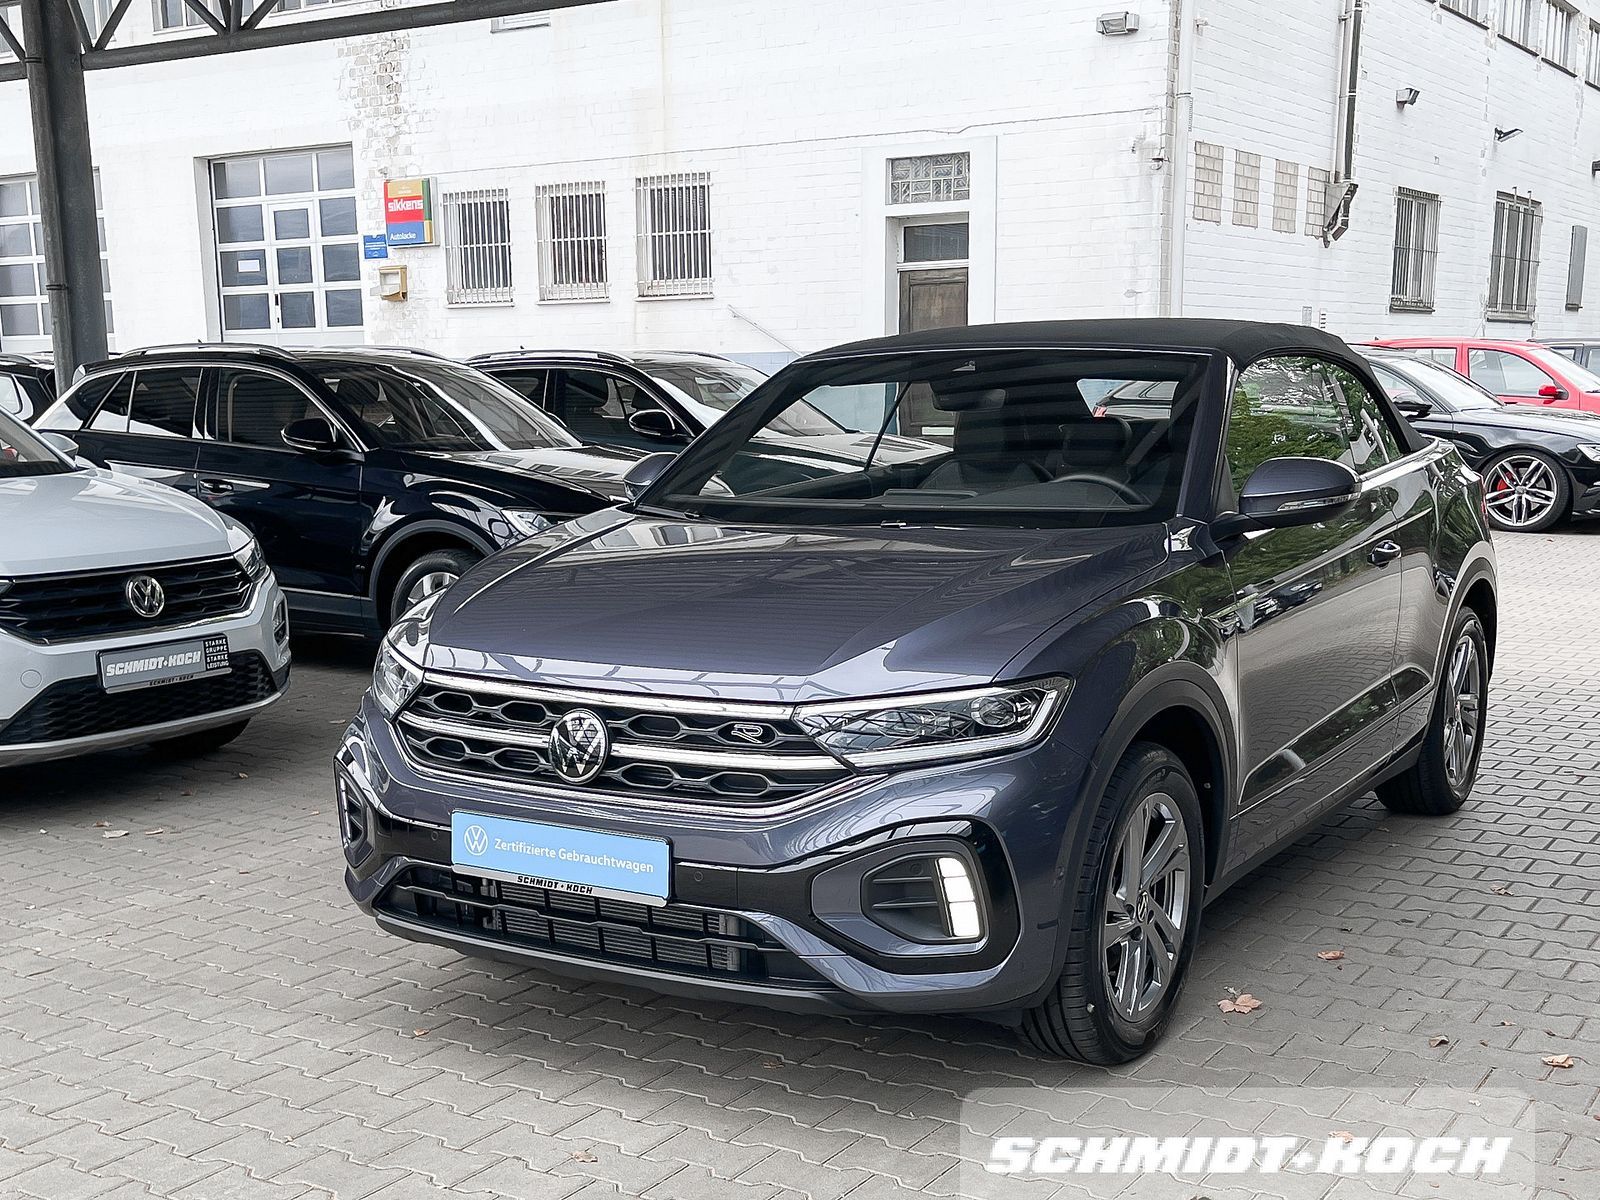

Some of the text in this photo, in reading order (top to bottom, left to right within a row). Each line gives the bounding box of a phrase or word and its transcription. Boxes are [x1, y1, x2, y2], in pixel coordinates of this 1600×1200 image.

[388, 199, 424, 211] sikkens
[206, 645, 227, 653] GRUPPE
[494, 838, 654, 873] Zertifizierte Gebrauchtwagen
[517, 875, 593, 895] SCHMIDT KOCH
